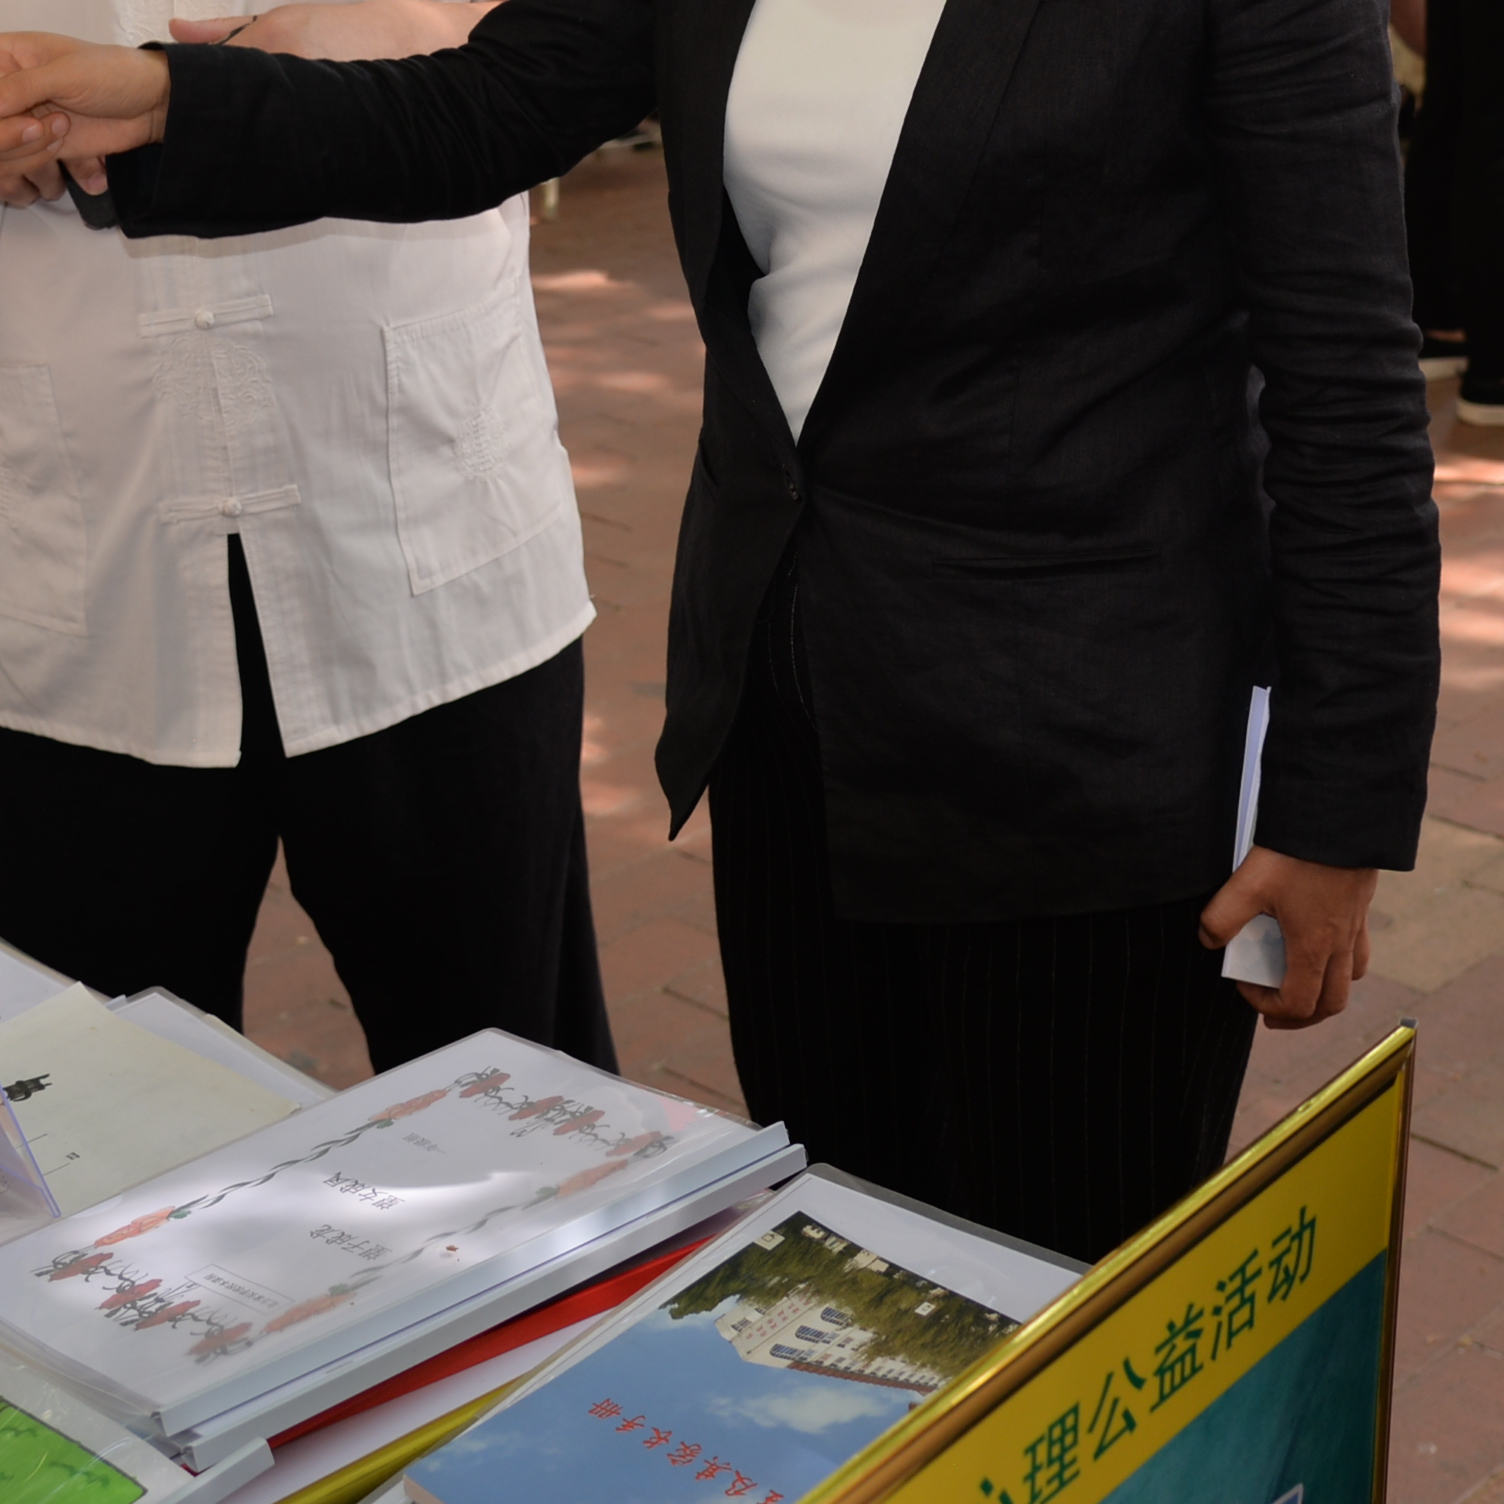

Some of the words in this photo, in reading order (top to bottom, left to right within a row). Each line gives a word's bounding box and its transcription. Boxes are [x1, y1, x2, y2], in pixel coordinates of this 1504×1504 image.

[323, 1172, 405, 1211] 望女成凤
[306, 1223, 392, 1262] 望子成龙
